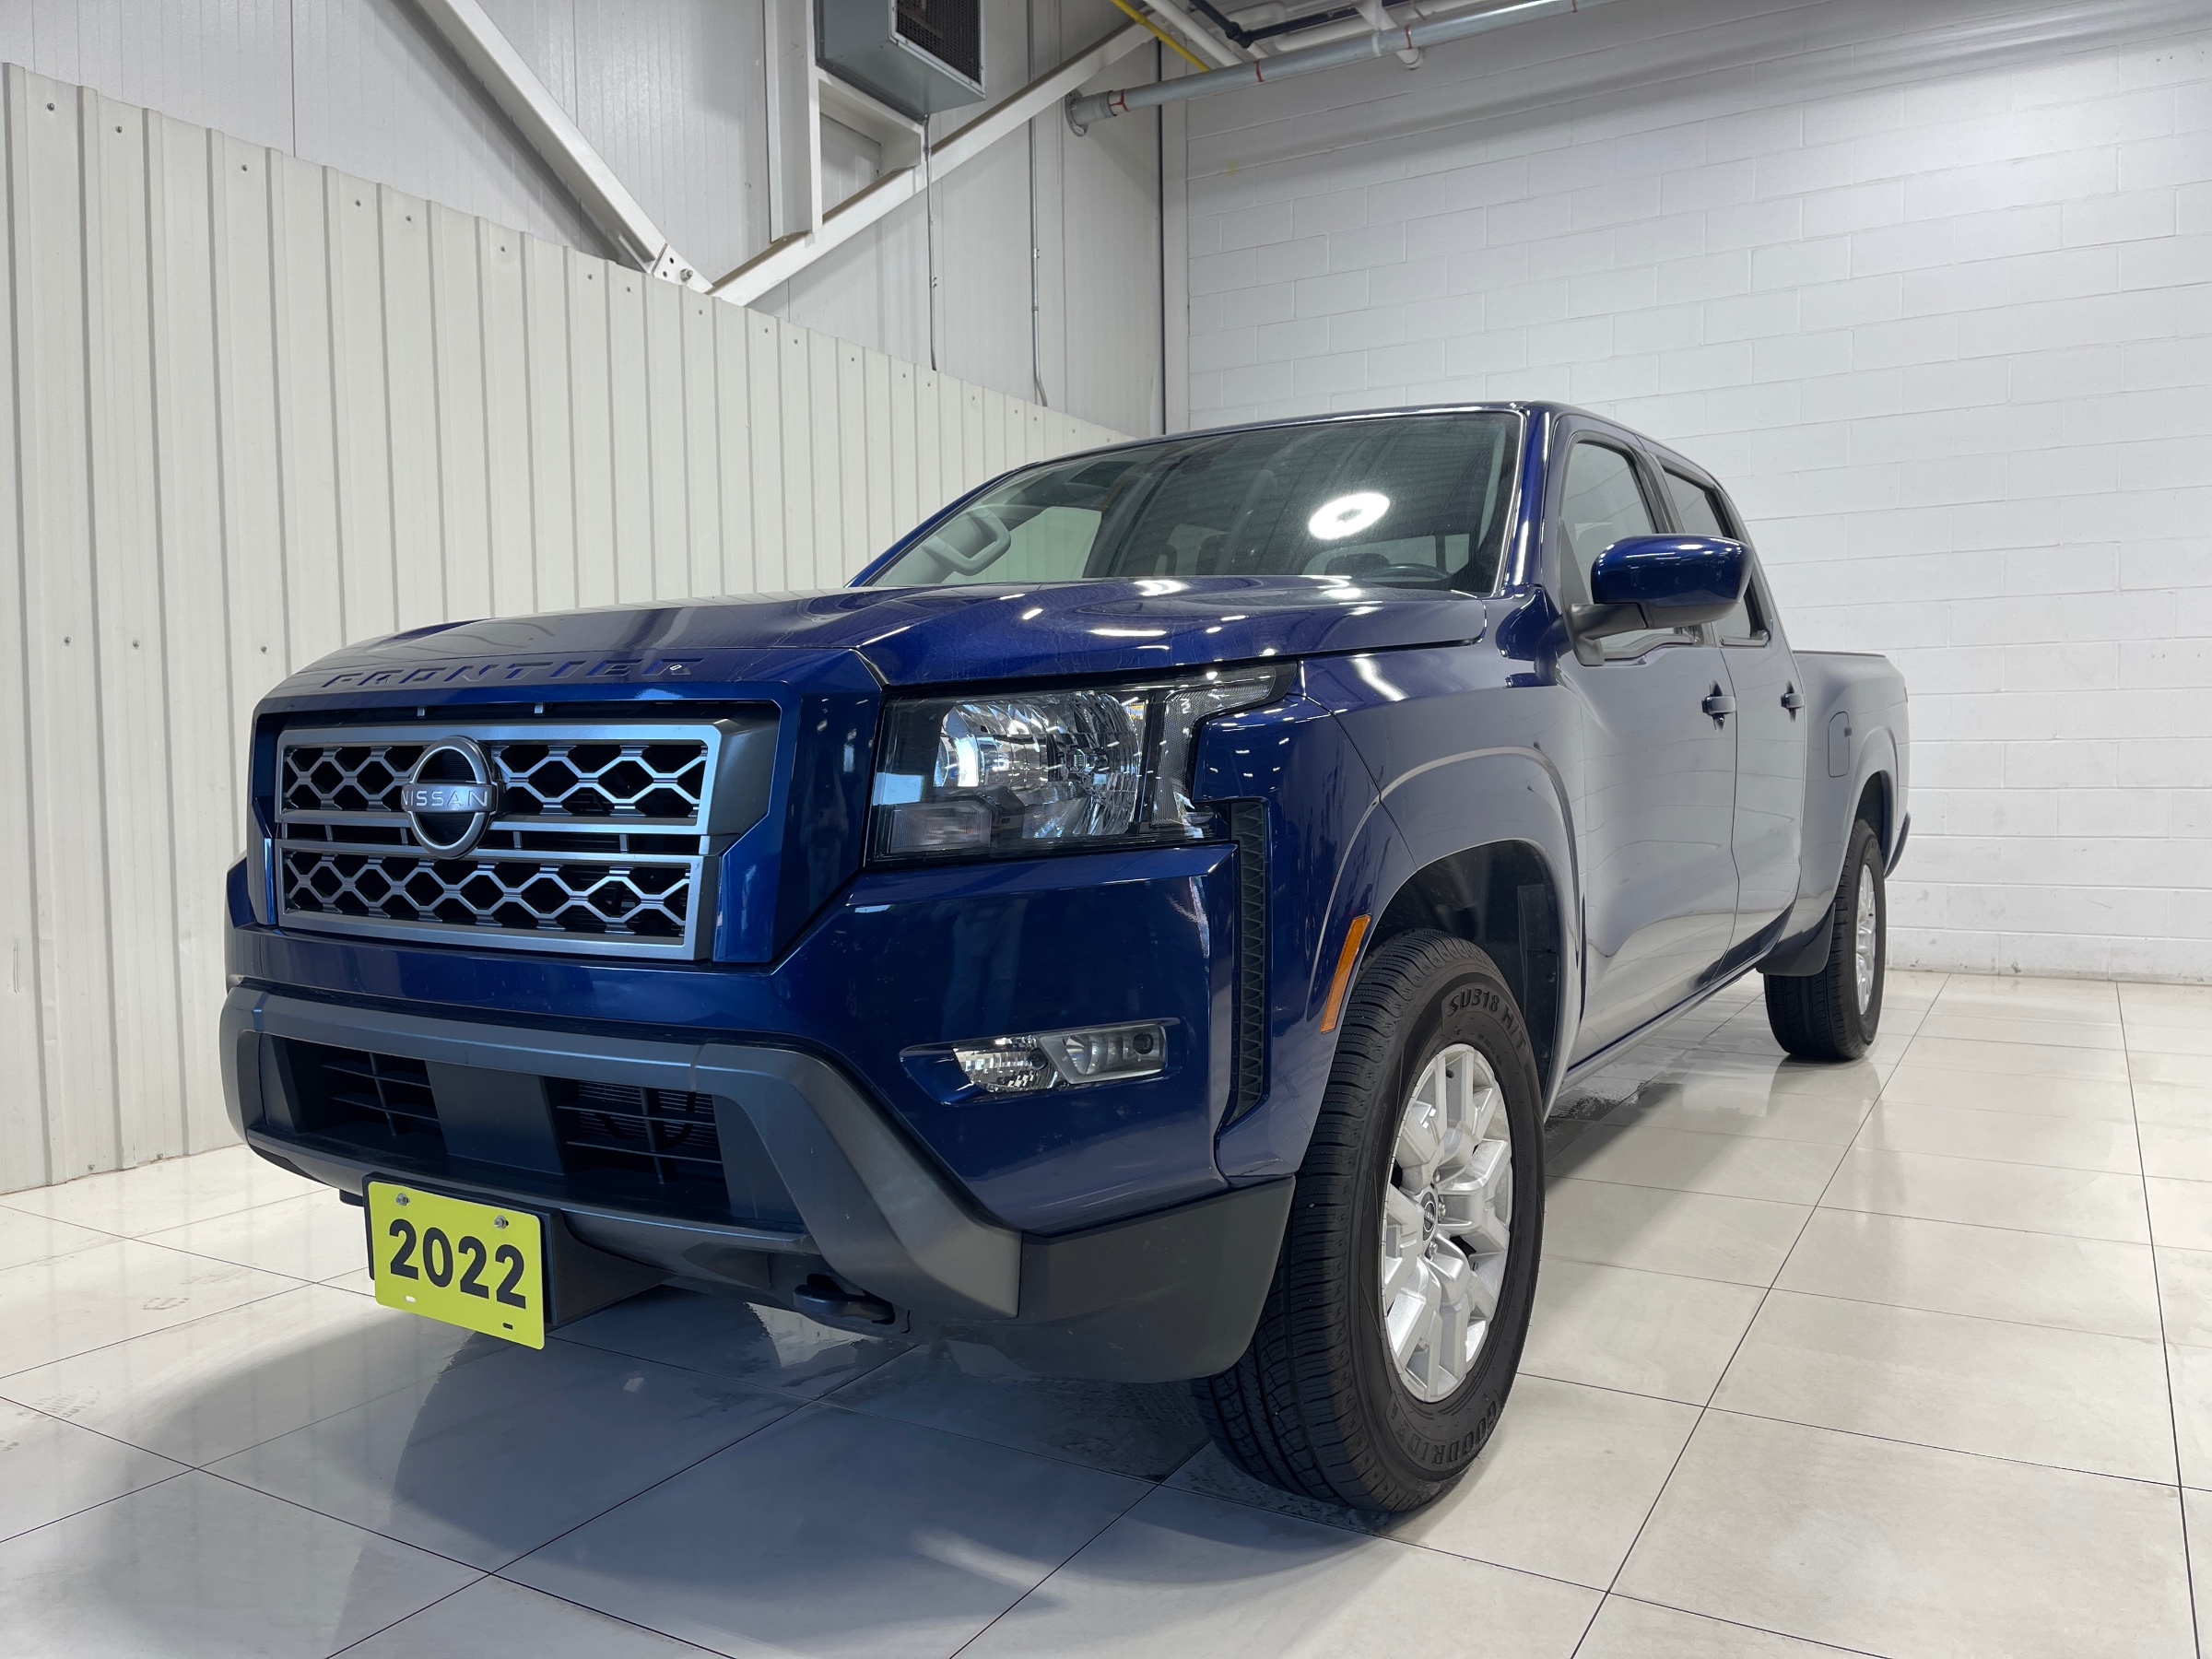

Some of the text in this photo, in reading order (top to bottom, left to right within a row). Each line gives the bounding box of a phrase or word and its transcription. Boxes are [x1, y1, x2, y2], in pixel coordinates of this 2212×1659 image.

[321, 657, 705, 688] FRONTIER
[401, 790, 488, 806] NISSAN
[1447, 987, 1500, 1018] SU318
[388, 1218, 526, 1310] 2022
